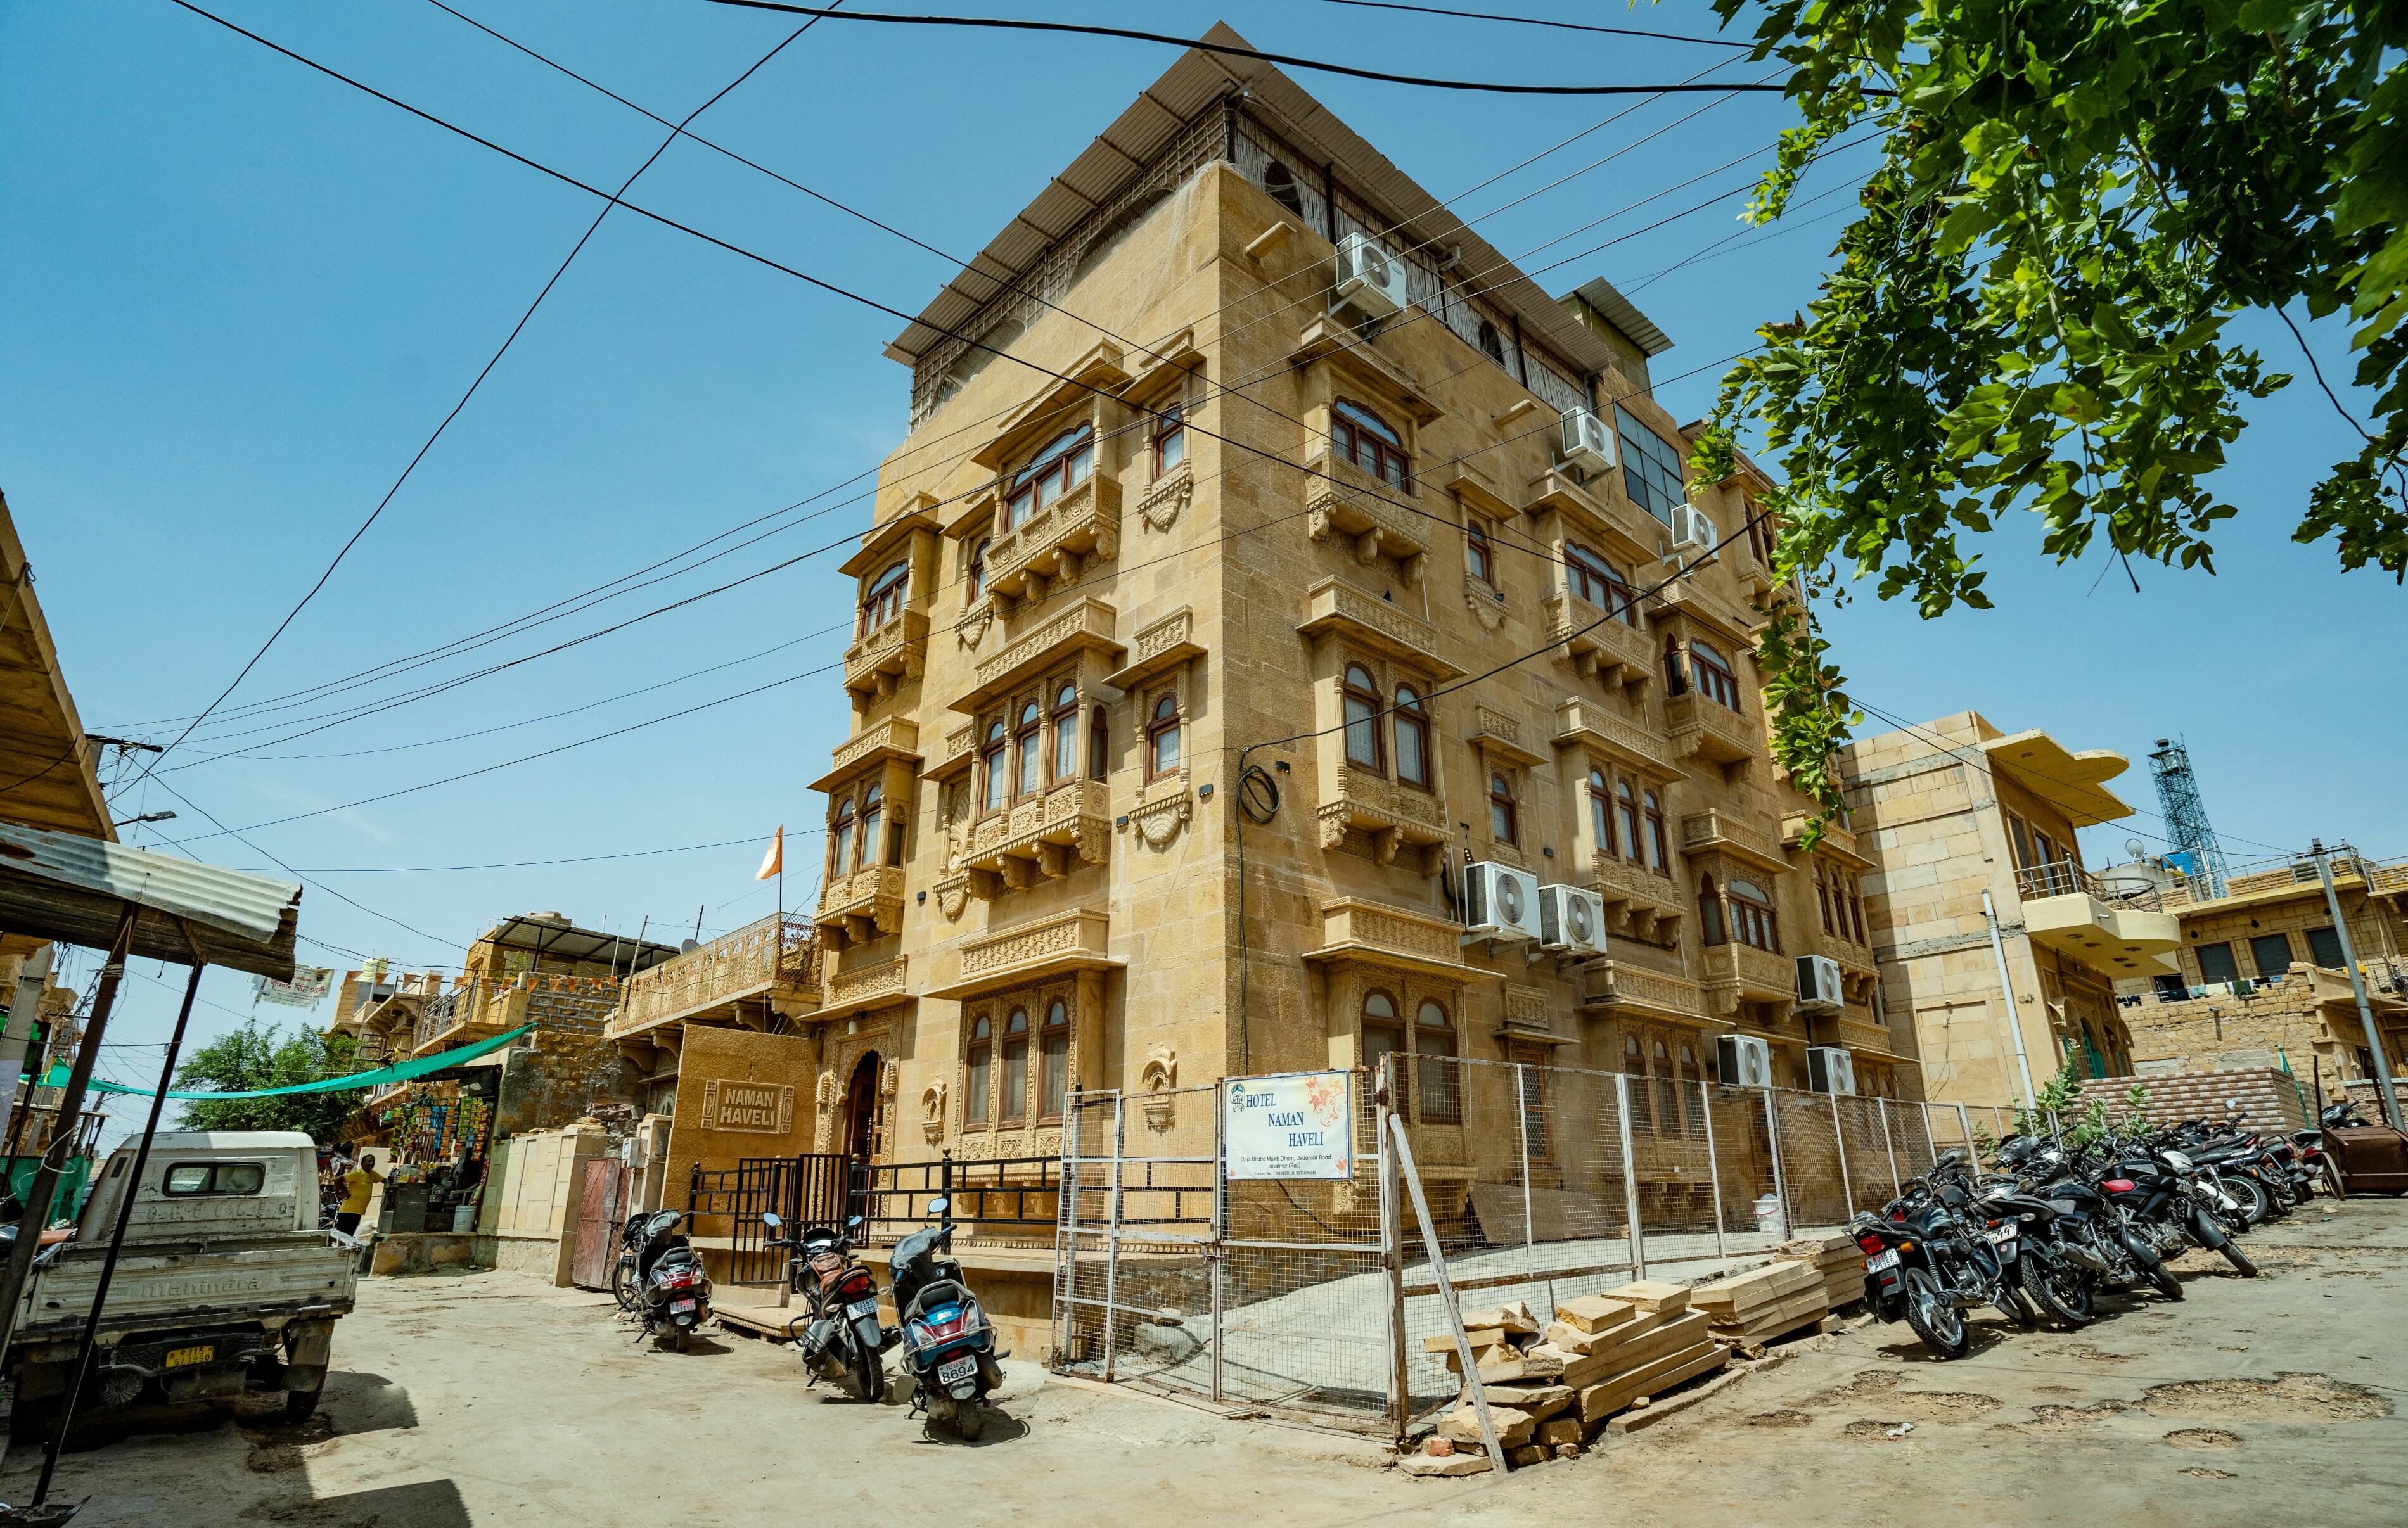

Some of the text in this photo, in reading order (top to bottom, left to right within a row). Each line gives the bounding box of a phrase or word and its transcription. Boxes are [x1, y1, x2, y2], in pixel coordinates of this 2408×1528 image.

[725, 1088, 774, 1107] NAMAN
[1246, 1093, 1276, 1108] HOTEL
[720, 1107, 776, 1126] HAVELI
[1268, 1112, 1304, 1127] NAMAN
[1288, 1131, 1324, 1147] HAVELI
[1873, 1251, 1892, 1264] RJ15S
[854, 1299, 874, 1310] RJ15S
[942, 1363, 975, 1382] 8694
[946, 1362, 959, 1371] RJ15
